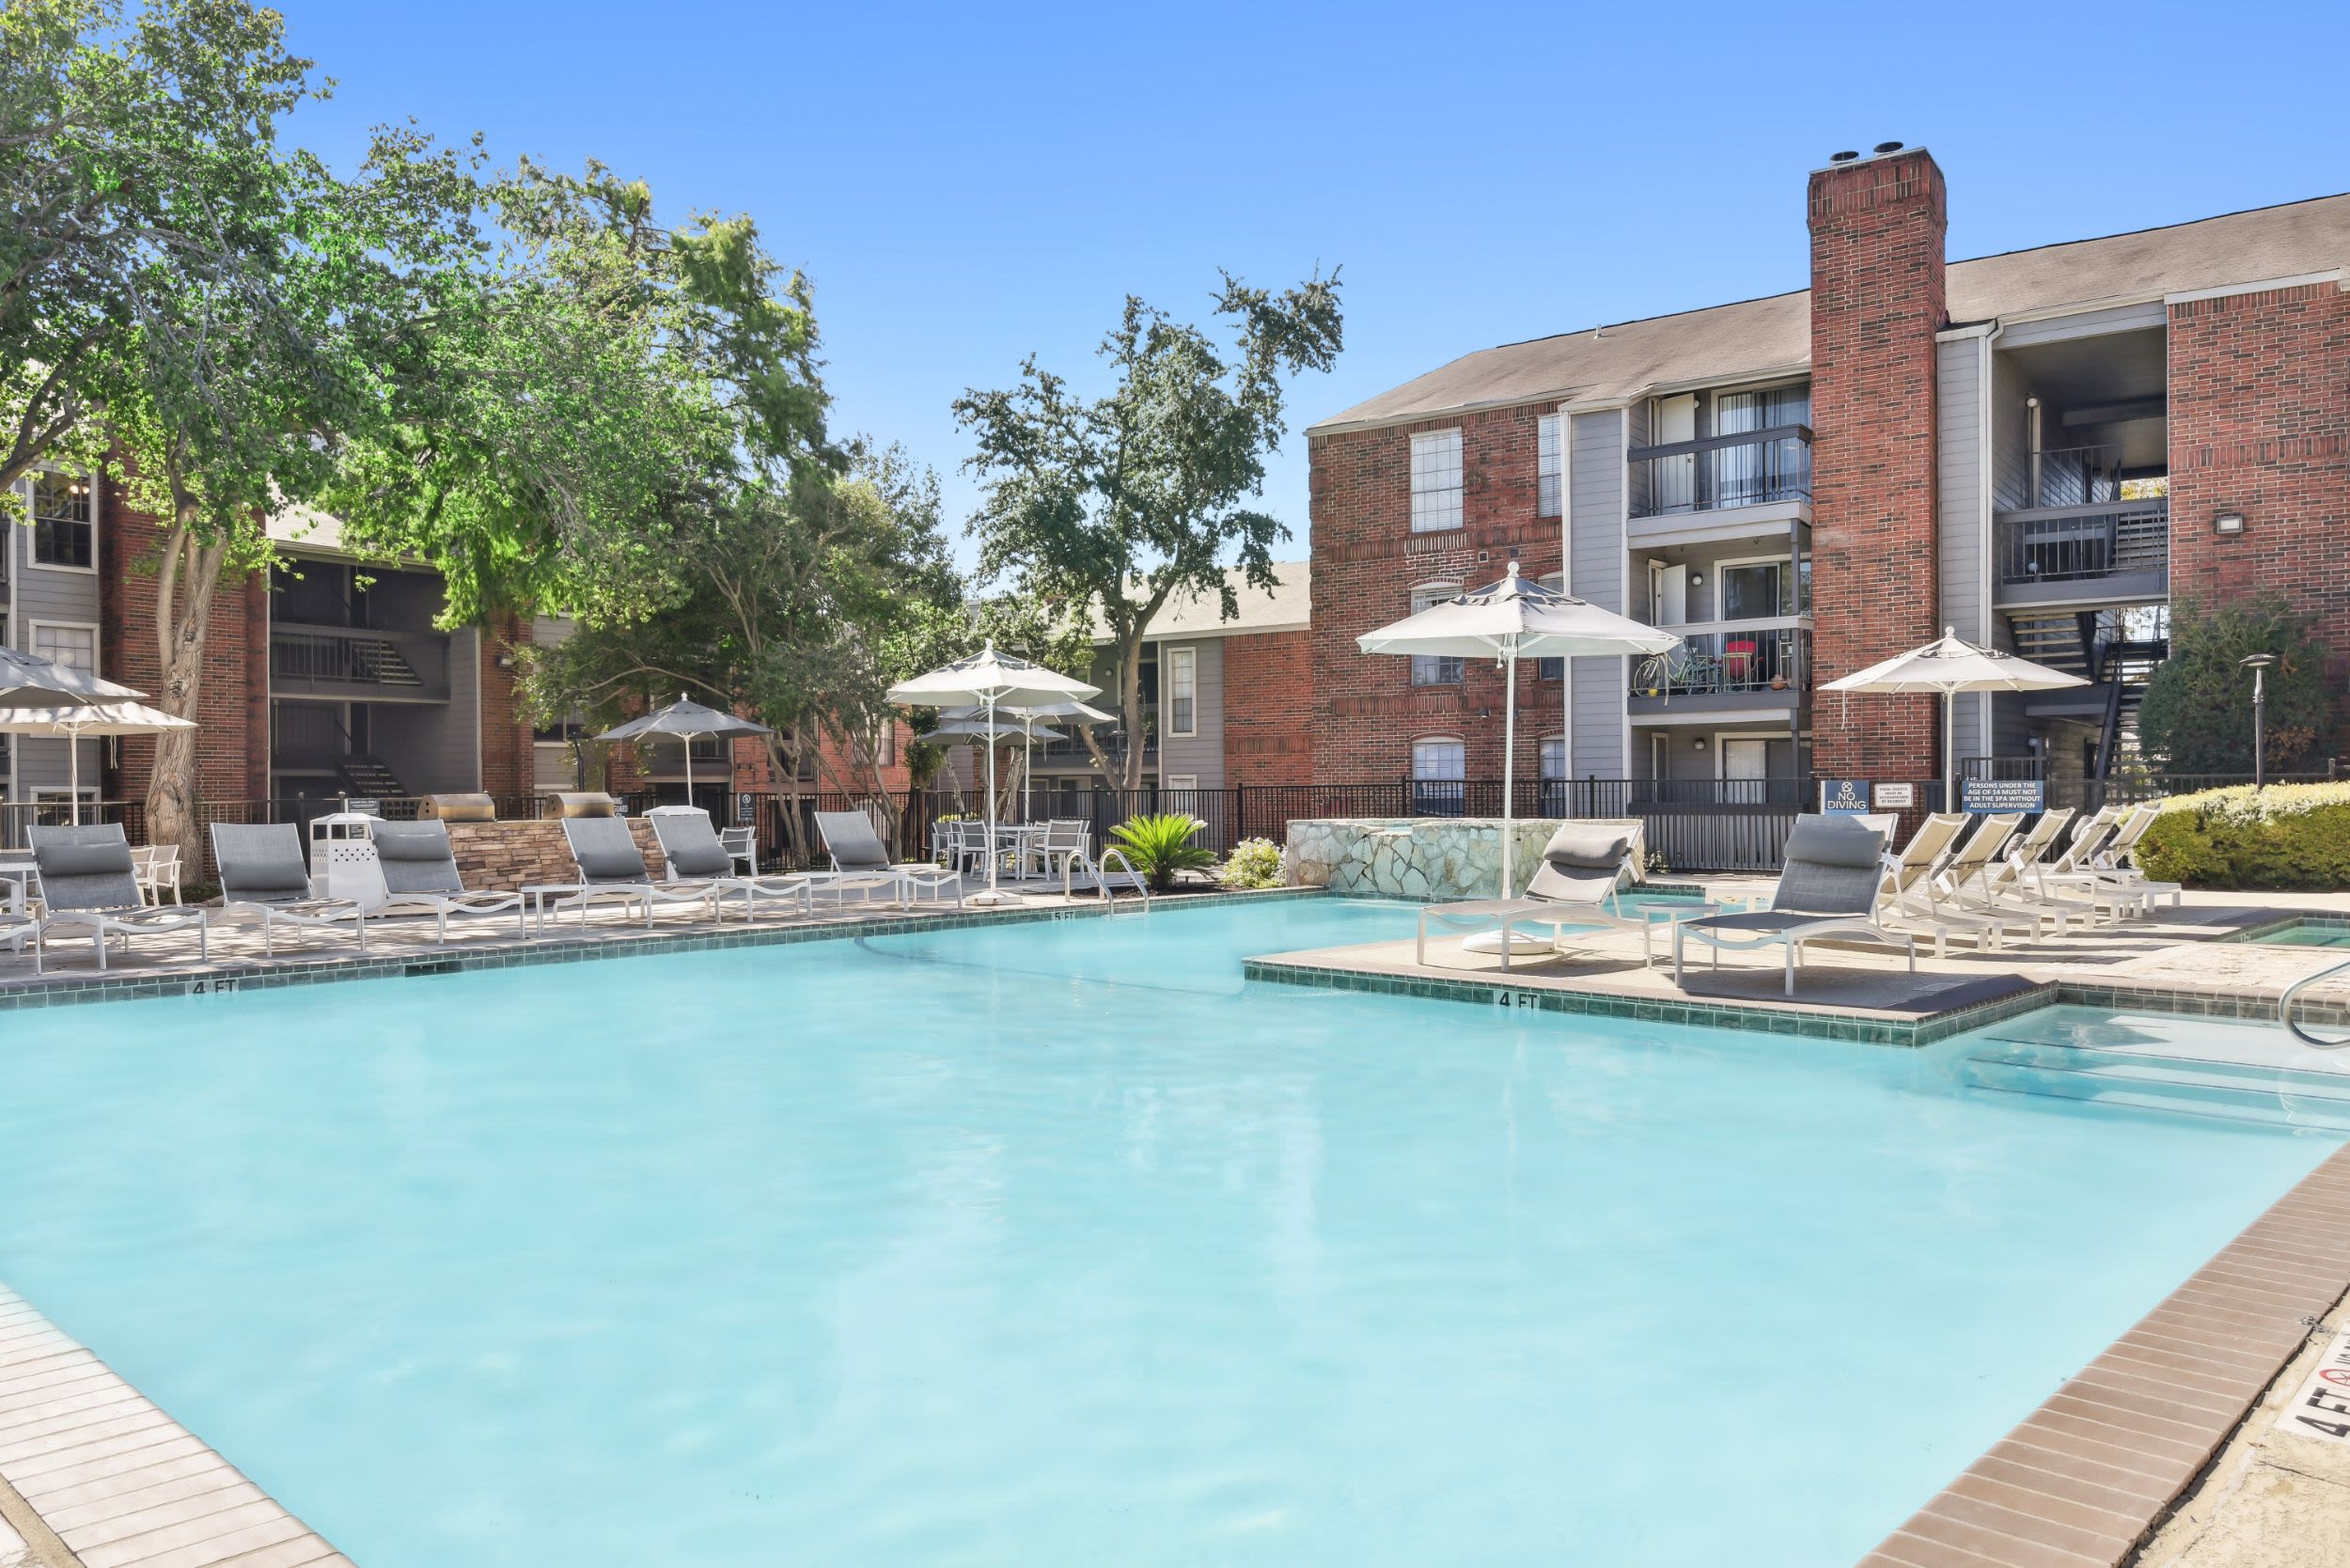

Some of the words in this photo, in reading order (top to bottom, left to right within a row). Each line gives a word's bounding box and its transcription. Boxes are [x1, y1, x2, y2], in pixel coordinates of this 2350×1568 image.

[1838, 792, 1856, 801] NO
[1827, 800, 1867, 809] DIVING
[1055, 912, 1061, 920] 5
[1064, 911, 1074, 920] FT
[193, 980, 206, 995] 4
[214, 979, 237, 994] FT
[1499, 991, 1511, 1007] 4
[1518, 993, 1538, 1010] FT
